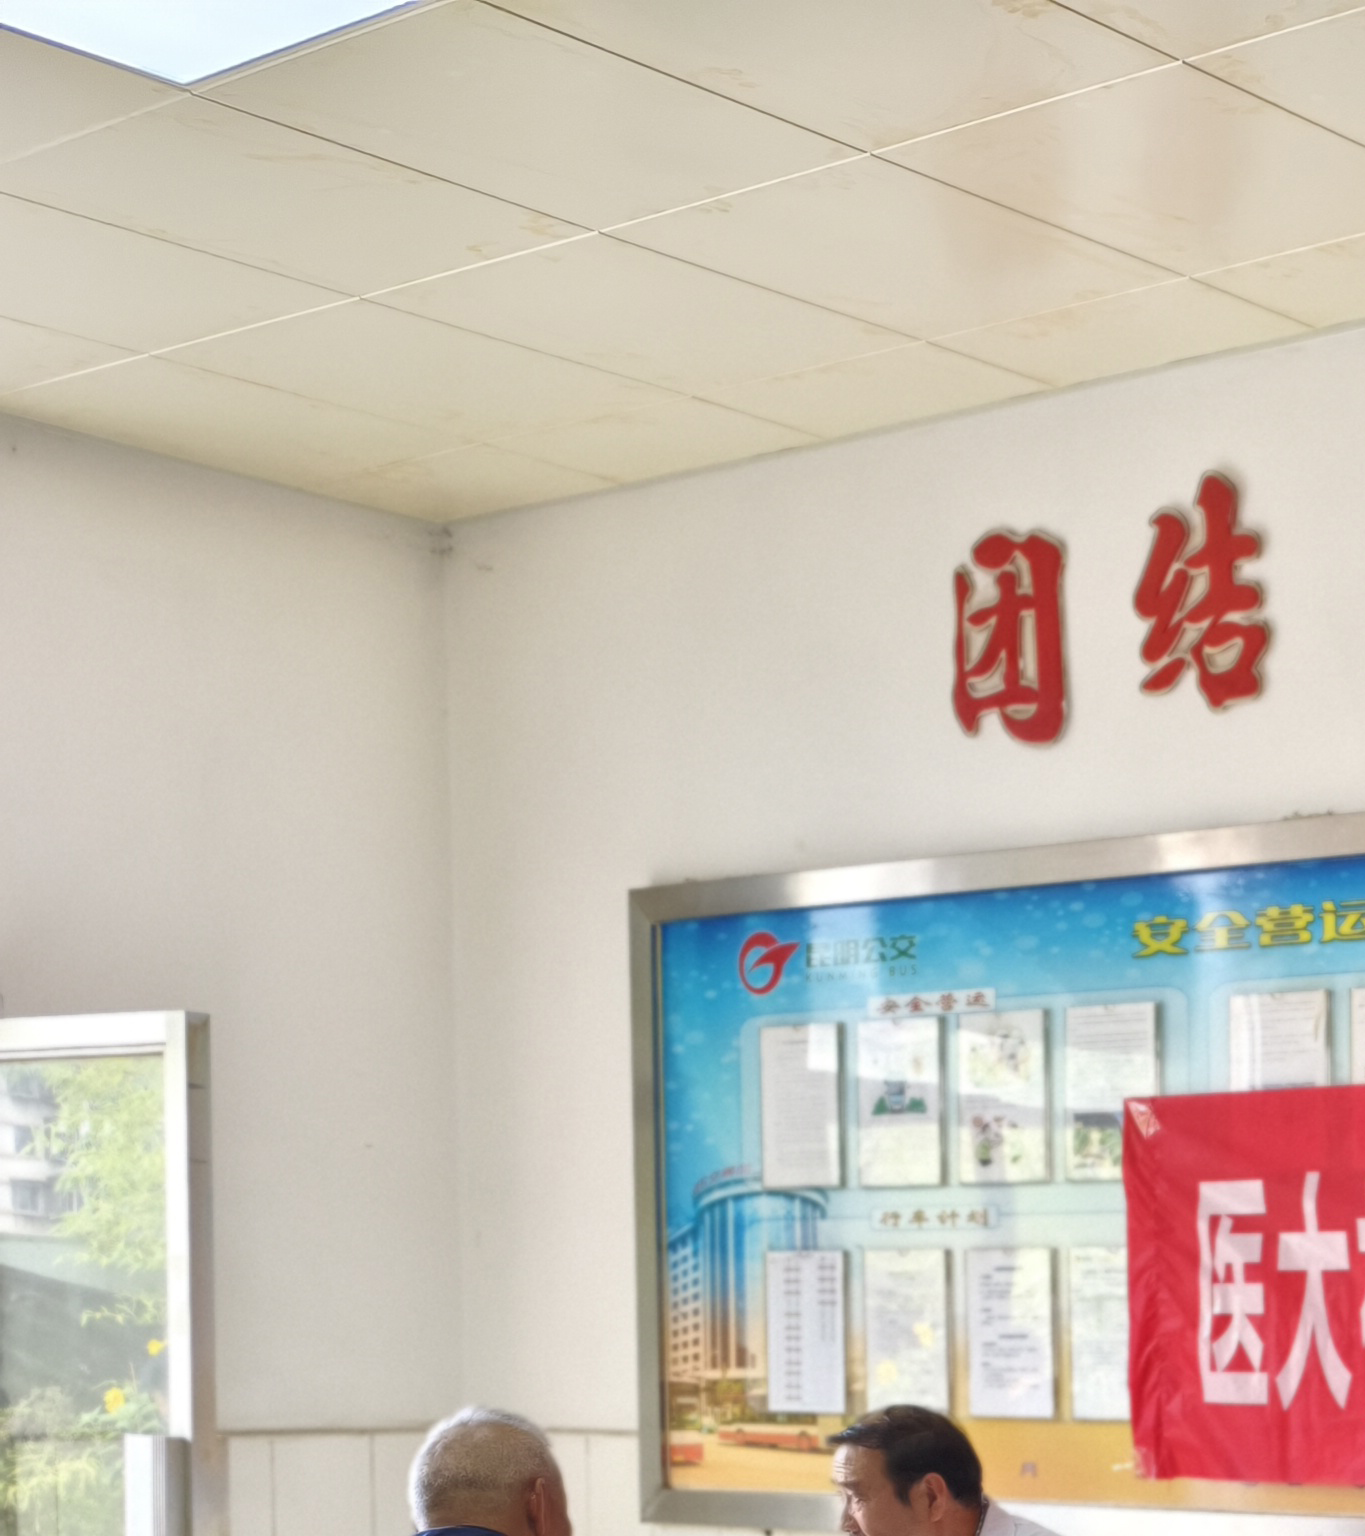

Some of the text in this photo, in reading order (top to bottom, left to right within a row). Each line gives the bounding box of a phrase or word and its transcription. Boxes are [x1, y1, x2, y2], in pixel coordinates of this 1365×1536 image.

[805, 934, 918, 969] 昆明公交
[889, 964, 918, 977] BUS
[876, 990, 989, 1015] 安全营运
